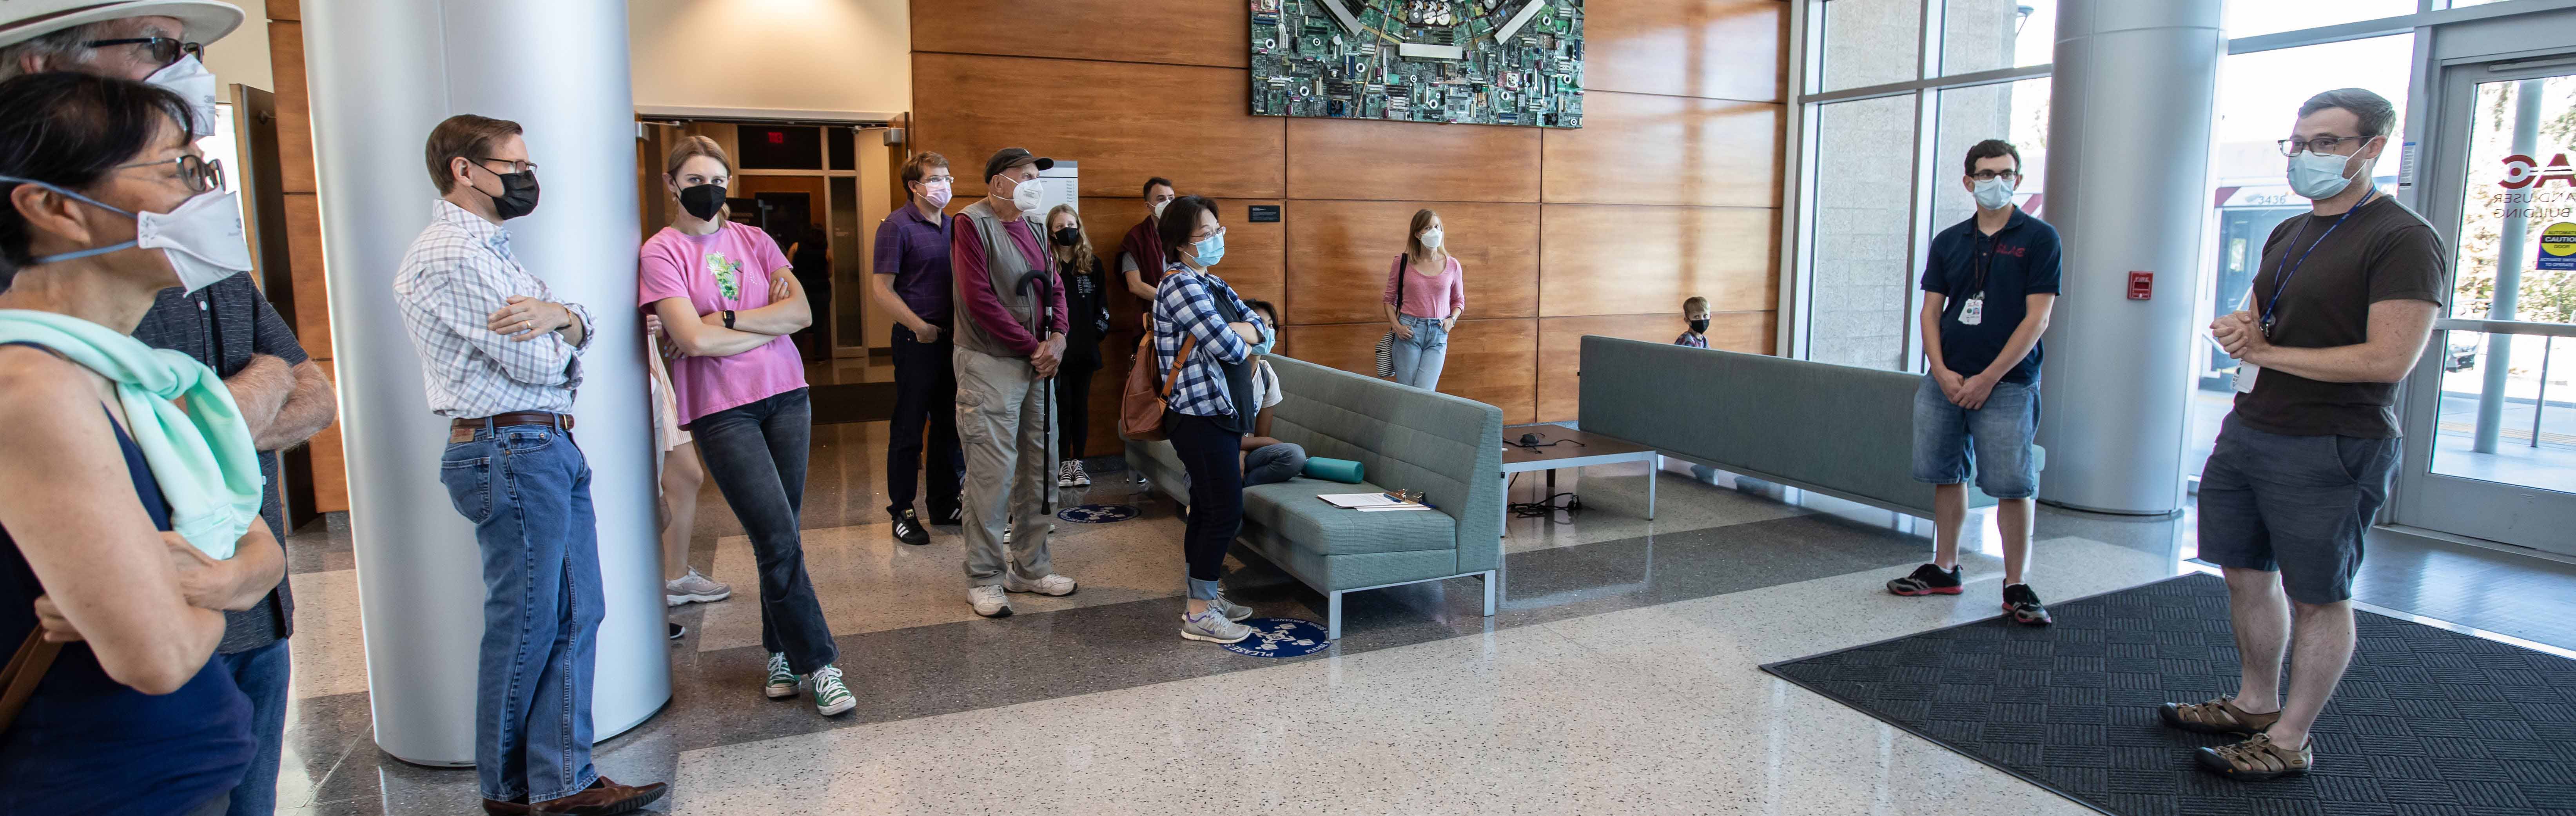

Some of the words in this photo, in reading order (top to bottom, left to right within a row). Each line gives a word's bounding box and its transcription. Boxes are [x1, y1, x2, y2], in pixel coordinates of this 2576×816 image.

[2258, 195, 2286, 205] 3436
[1307, 622, 1327, 631] SOCIAL
[1229, 646, 1274, 657] PLEASE
[1304, 643, 1328, 653] PLEASE
